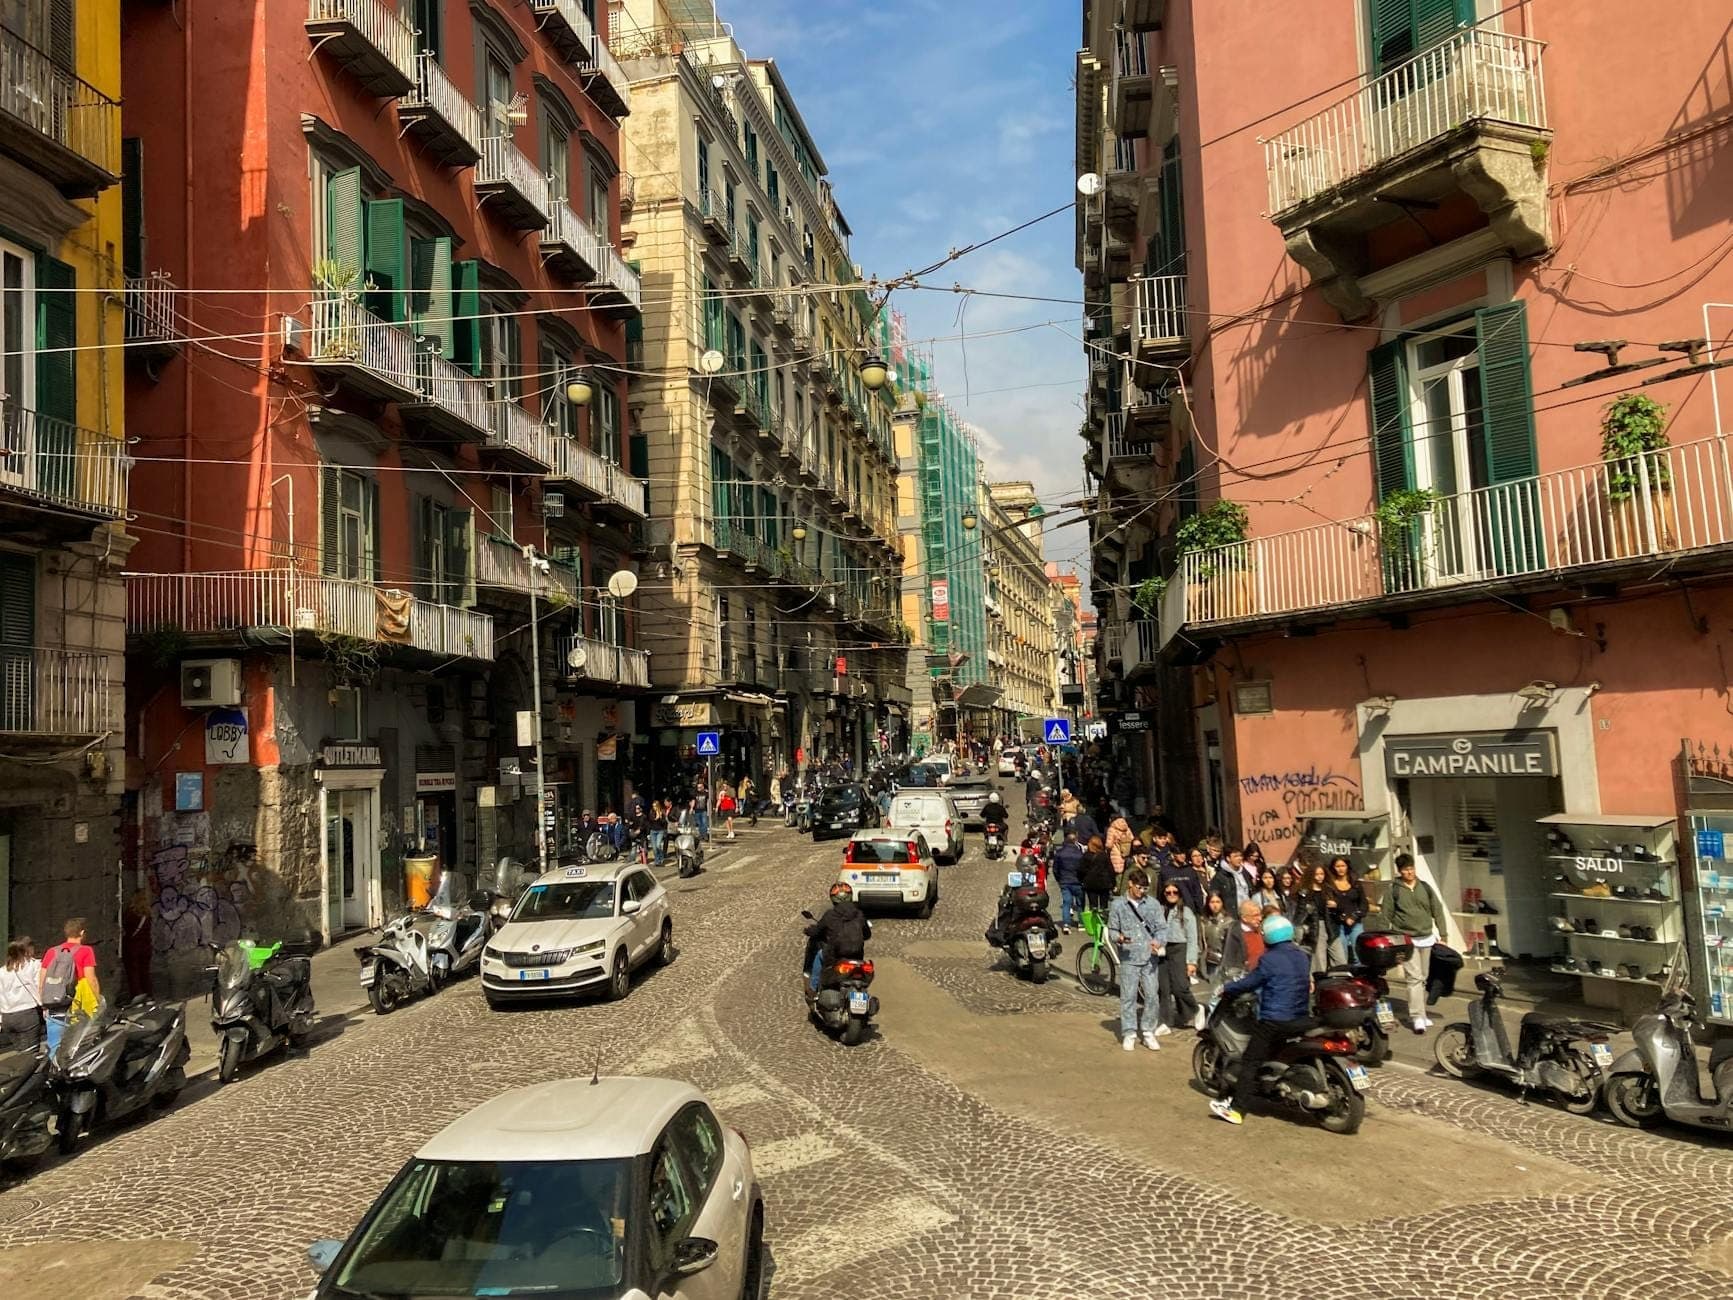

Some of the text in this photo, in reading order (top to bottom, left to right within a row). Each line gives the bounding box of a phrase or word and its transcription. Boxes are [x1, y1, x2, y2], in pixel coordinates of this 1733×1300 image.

[1090, 727, 1105, 735] GLS
[1118, 719, 1149, 730] Tessere
[210, 725, 245, 742] LOBBY
[323, 746, 381, 765] OUTLETMANIA
[1393, 753, 1543, 775] CAMPANILE
[1320, 841, 1352, 855] SALDI
[566, 868, 585, 876] TAXI
[1575, 856, 1623, 873] SALDI
